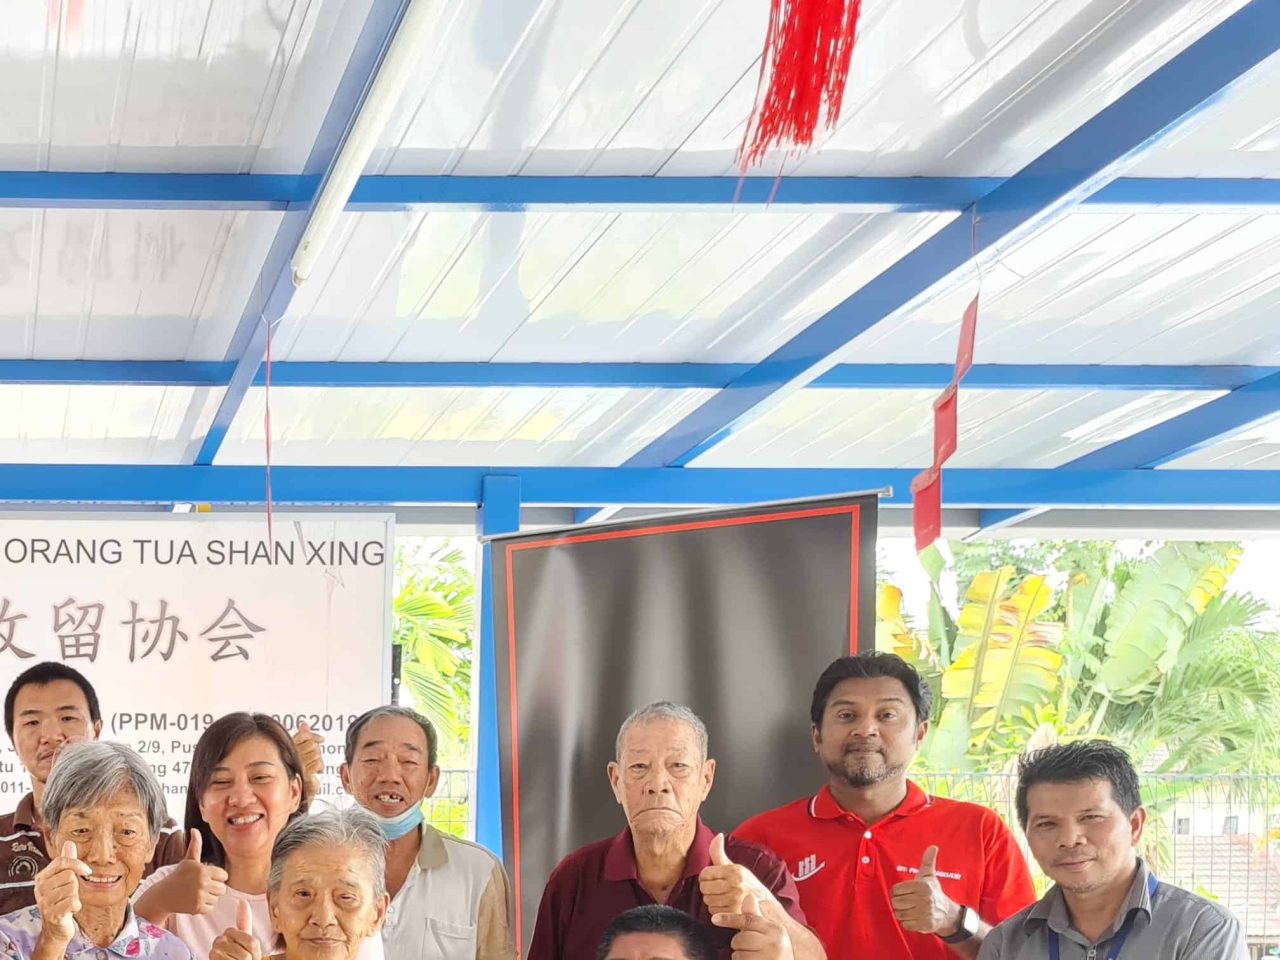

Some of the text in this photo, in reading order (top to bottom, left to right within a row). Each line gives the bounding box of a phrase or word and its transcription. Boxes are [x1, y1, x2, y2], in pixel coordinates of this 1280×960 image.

[4, 538, 122, 564] ORANG
[133, 539, 198, 565] TUA
[206, 539, 294, 566] SHAN
[306, 540, 385, 566] XING
[138, 740, 165, 755] 2/9,
